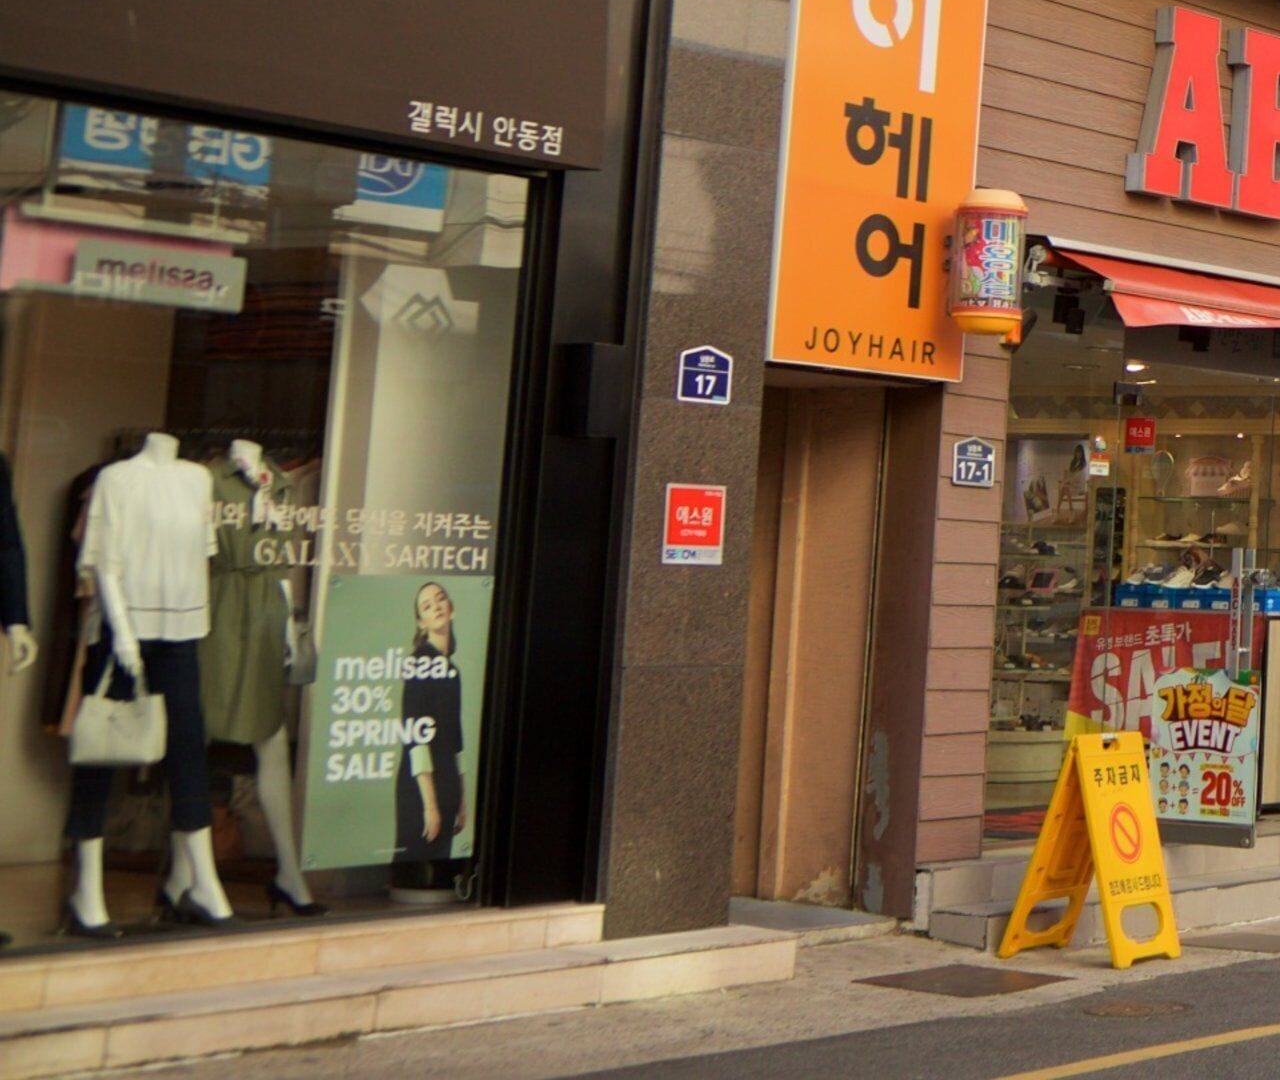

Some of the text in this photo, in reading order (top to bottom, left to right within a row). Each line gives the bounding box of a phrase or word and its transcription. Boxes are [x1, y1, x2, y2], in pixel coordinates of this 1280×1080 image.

[408, 100, 565, 157] 갤럭시 안동점
[803, 323, 937, 368] JOYHAIR
[694, 373, 717, 397] 17
[958, 461, 990, 480] 17-1
[412, 510, 492, 541] 지켜주는
[676, 505, 714, 527] 에스원
[385, 543, 489, 571] SARTECH
[334, 646, 458, 681] melissa.
[331, 684, 394, 715] 30%
[329, 716, 437, 748] SPRING
[1168, 720, 1240, 753] EVENT
[326, 751, 396, 782] SALE
